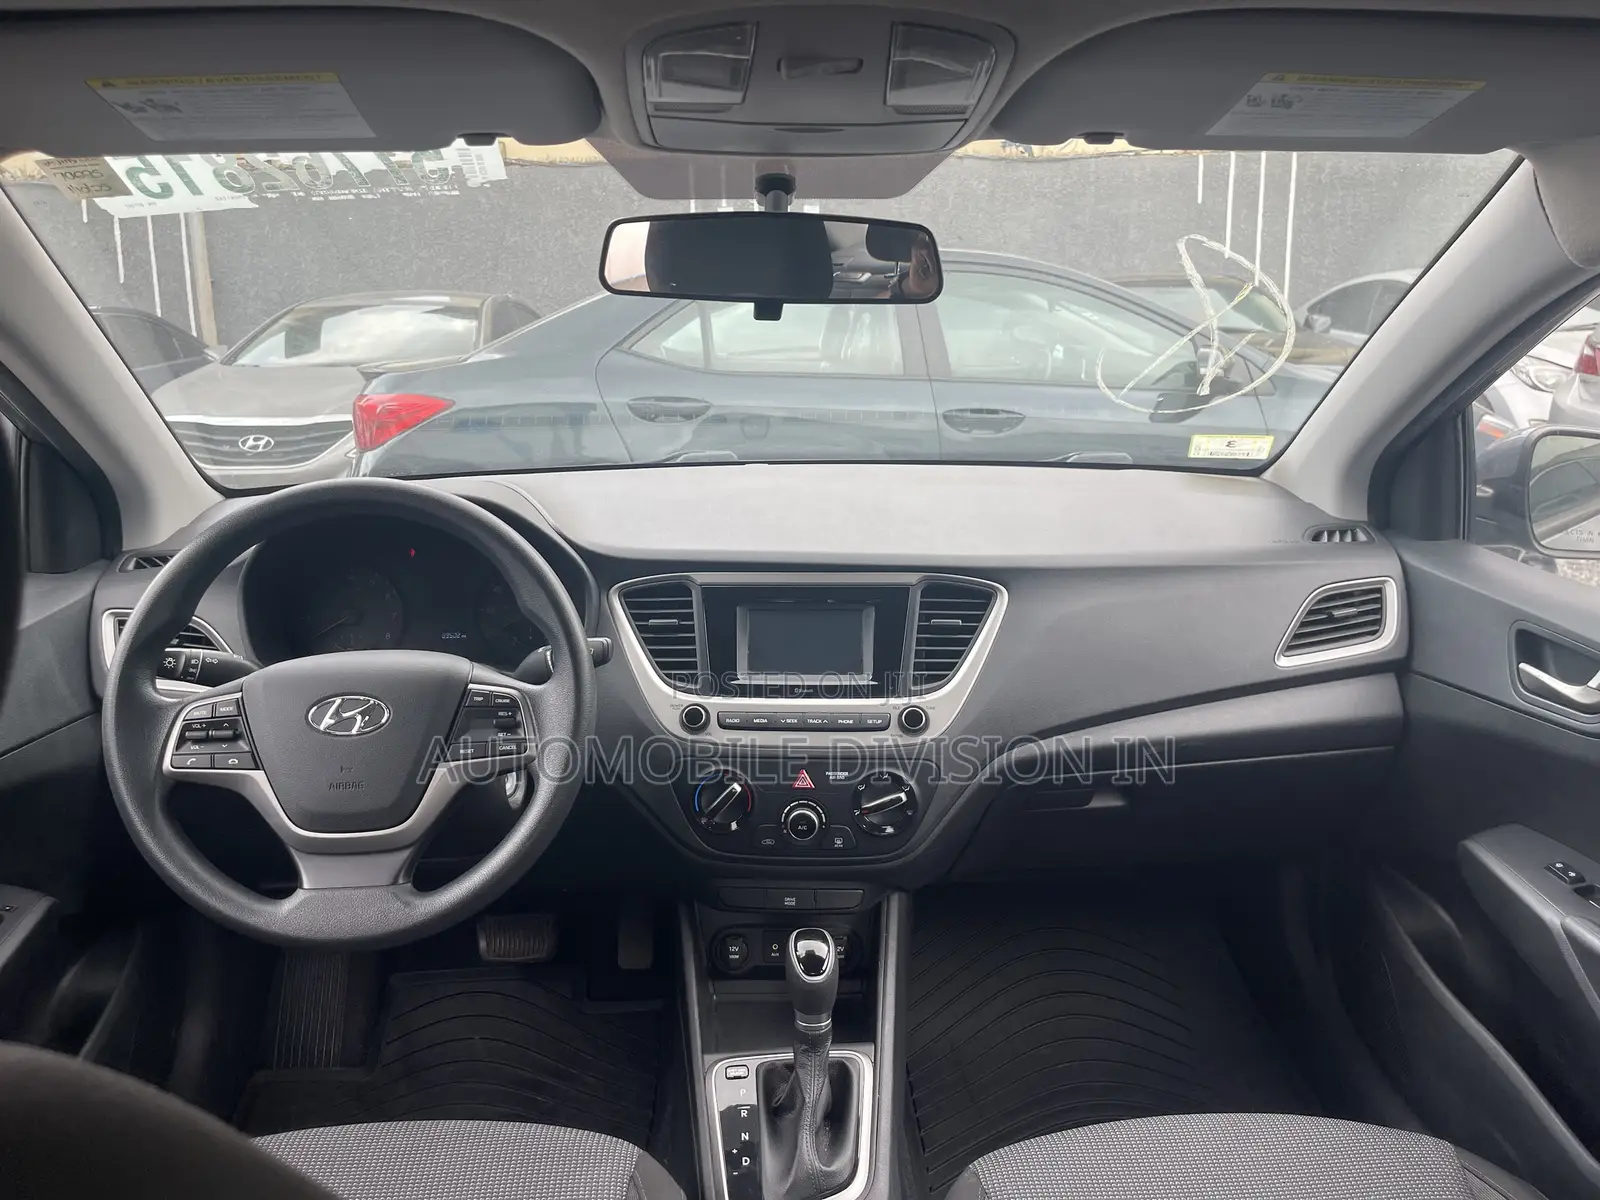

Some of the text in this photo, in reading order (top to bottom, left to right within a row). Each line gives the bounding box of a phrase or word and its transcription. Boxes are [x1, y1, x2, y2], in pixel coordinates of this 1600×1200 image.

[328, 781, 366, 791] AIRBAG
[740, 1089, 747, 1097] P
[740, 1110, 748, 1118] R
[741, 1132, 749, 1140] N
[742, 1156, 750, 1165] D
